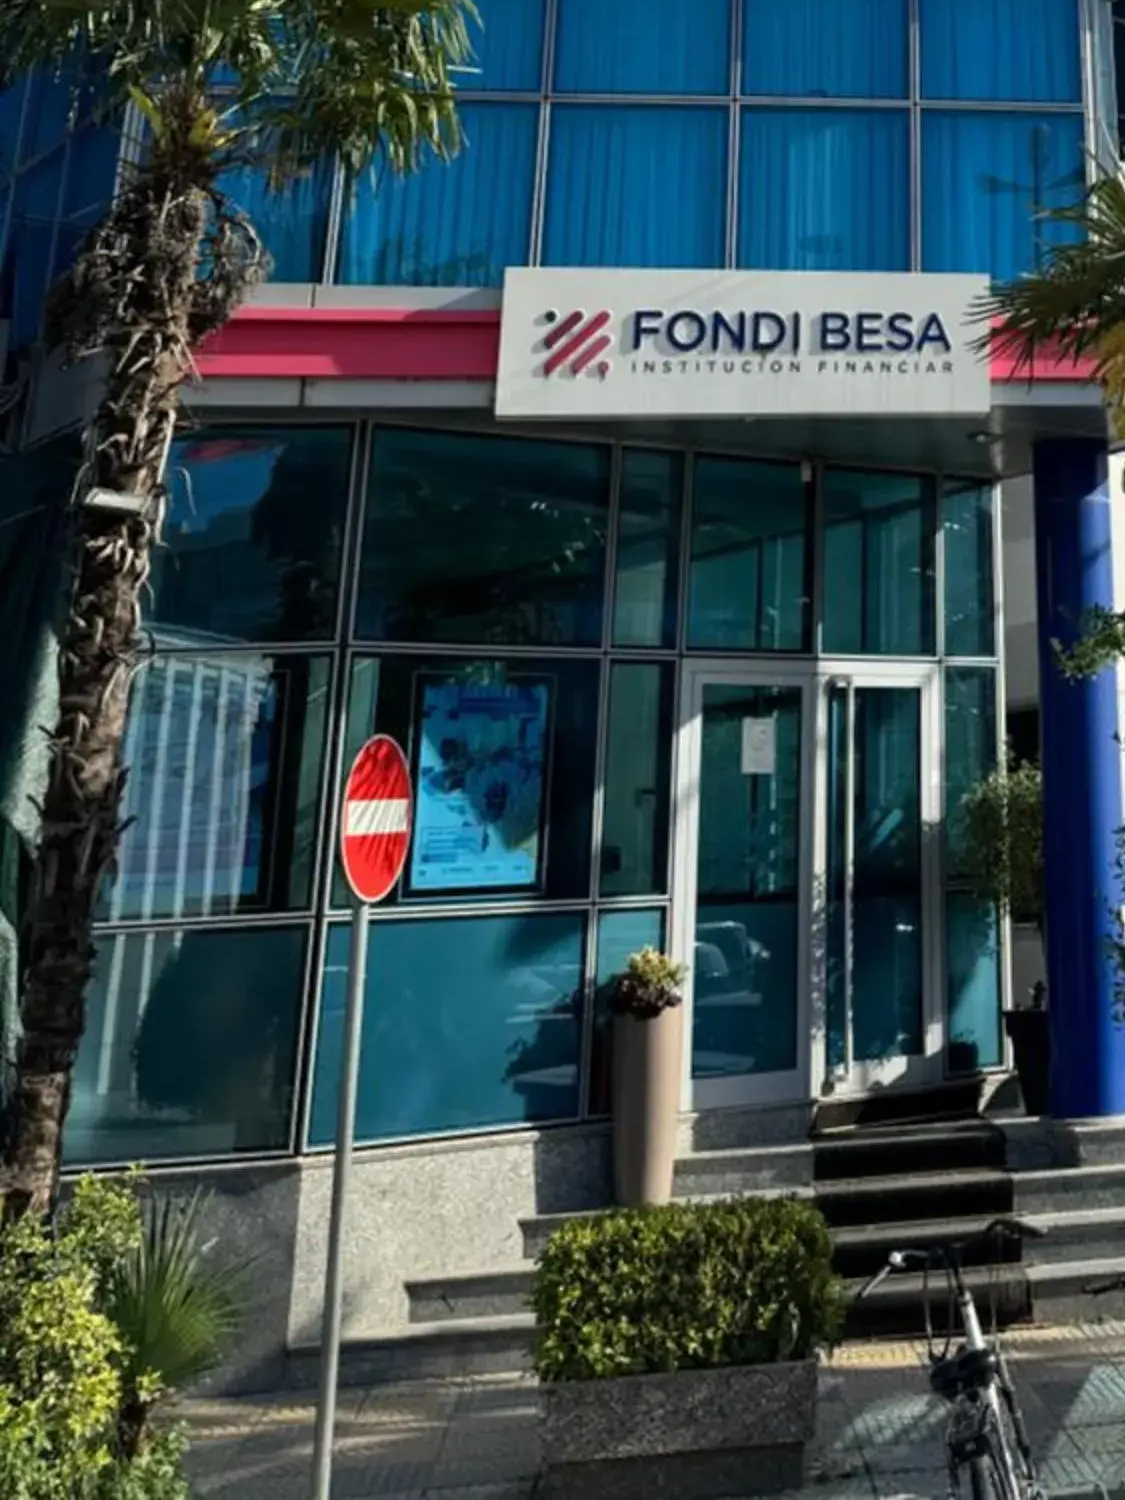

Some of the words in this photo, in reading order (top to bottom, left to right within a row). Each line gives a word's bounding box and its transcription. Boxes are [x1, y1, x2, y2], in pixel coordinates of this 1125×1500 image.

[632, 310, 801, 355] FONDI
[820, 312, 951, 353] BESA
[631, 360, 802, 374] INSTITUCION
[818, 360, 954, 374] FINANCIAR
